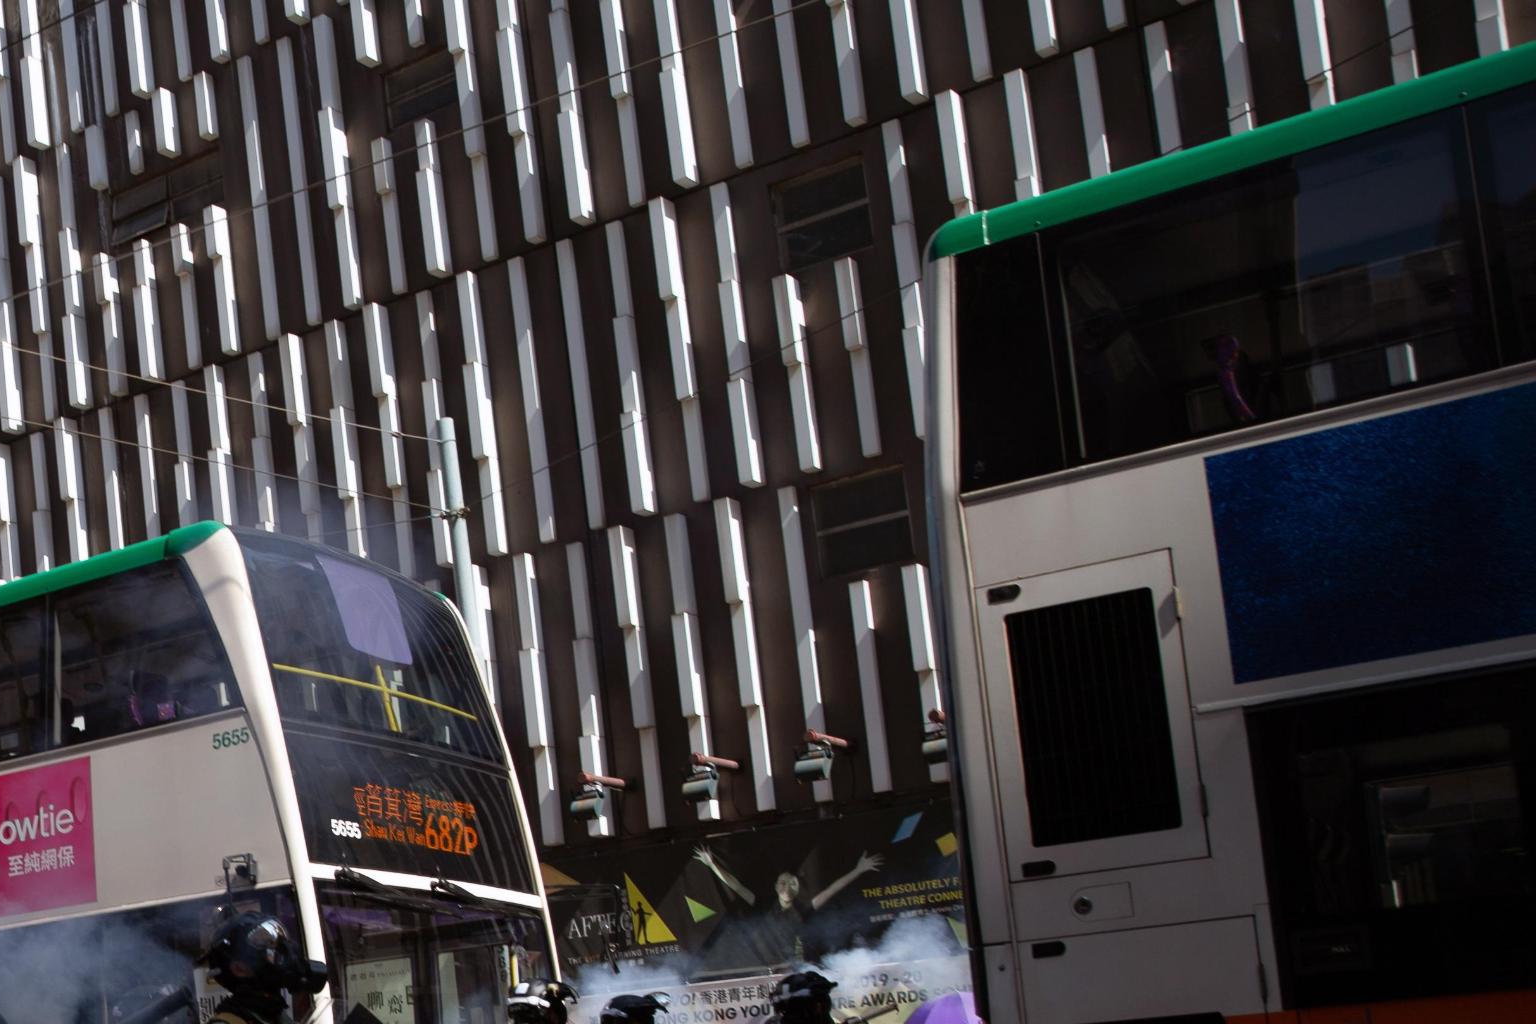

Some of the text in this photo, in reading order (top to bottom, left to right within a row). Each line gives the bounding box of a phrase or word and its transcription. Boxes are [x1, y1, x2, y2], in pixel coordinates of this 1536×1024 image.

[212, 727, 251, 751] 5655
[330, 818, 362, 839] 5655
[425, 813, 479, 856] 682P
[8, 845, 75, 878] 至純網保
[862, 887, 883, 898] THE
[884, 877, 951, 896] ABSOLUTELY
[879, 895, 926, 910] THEATRE
[694, 1007, 737, 1024] KONG
[861, 988, 928, 1008] AWARDS
